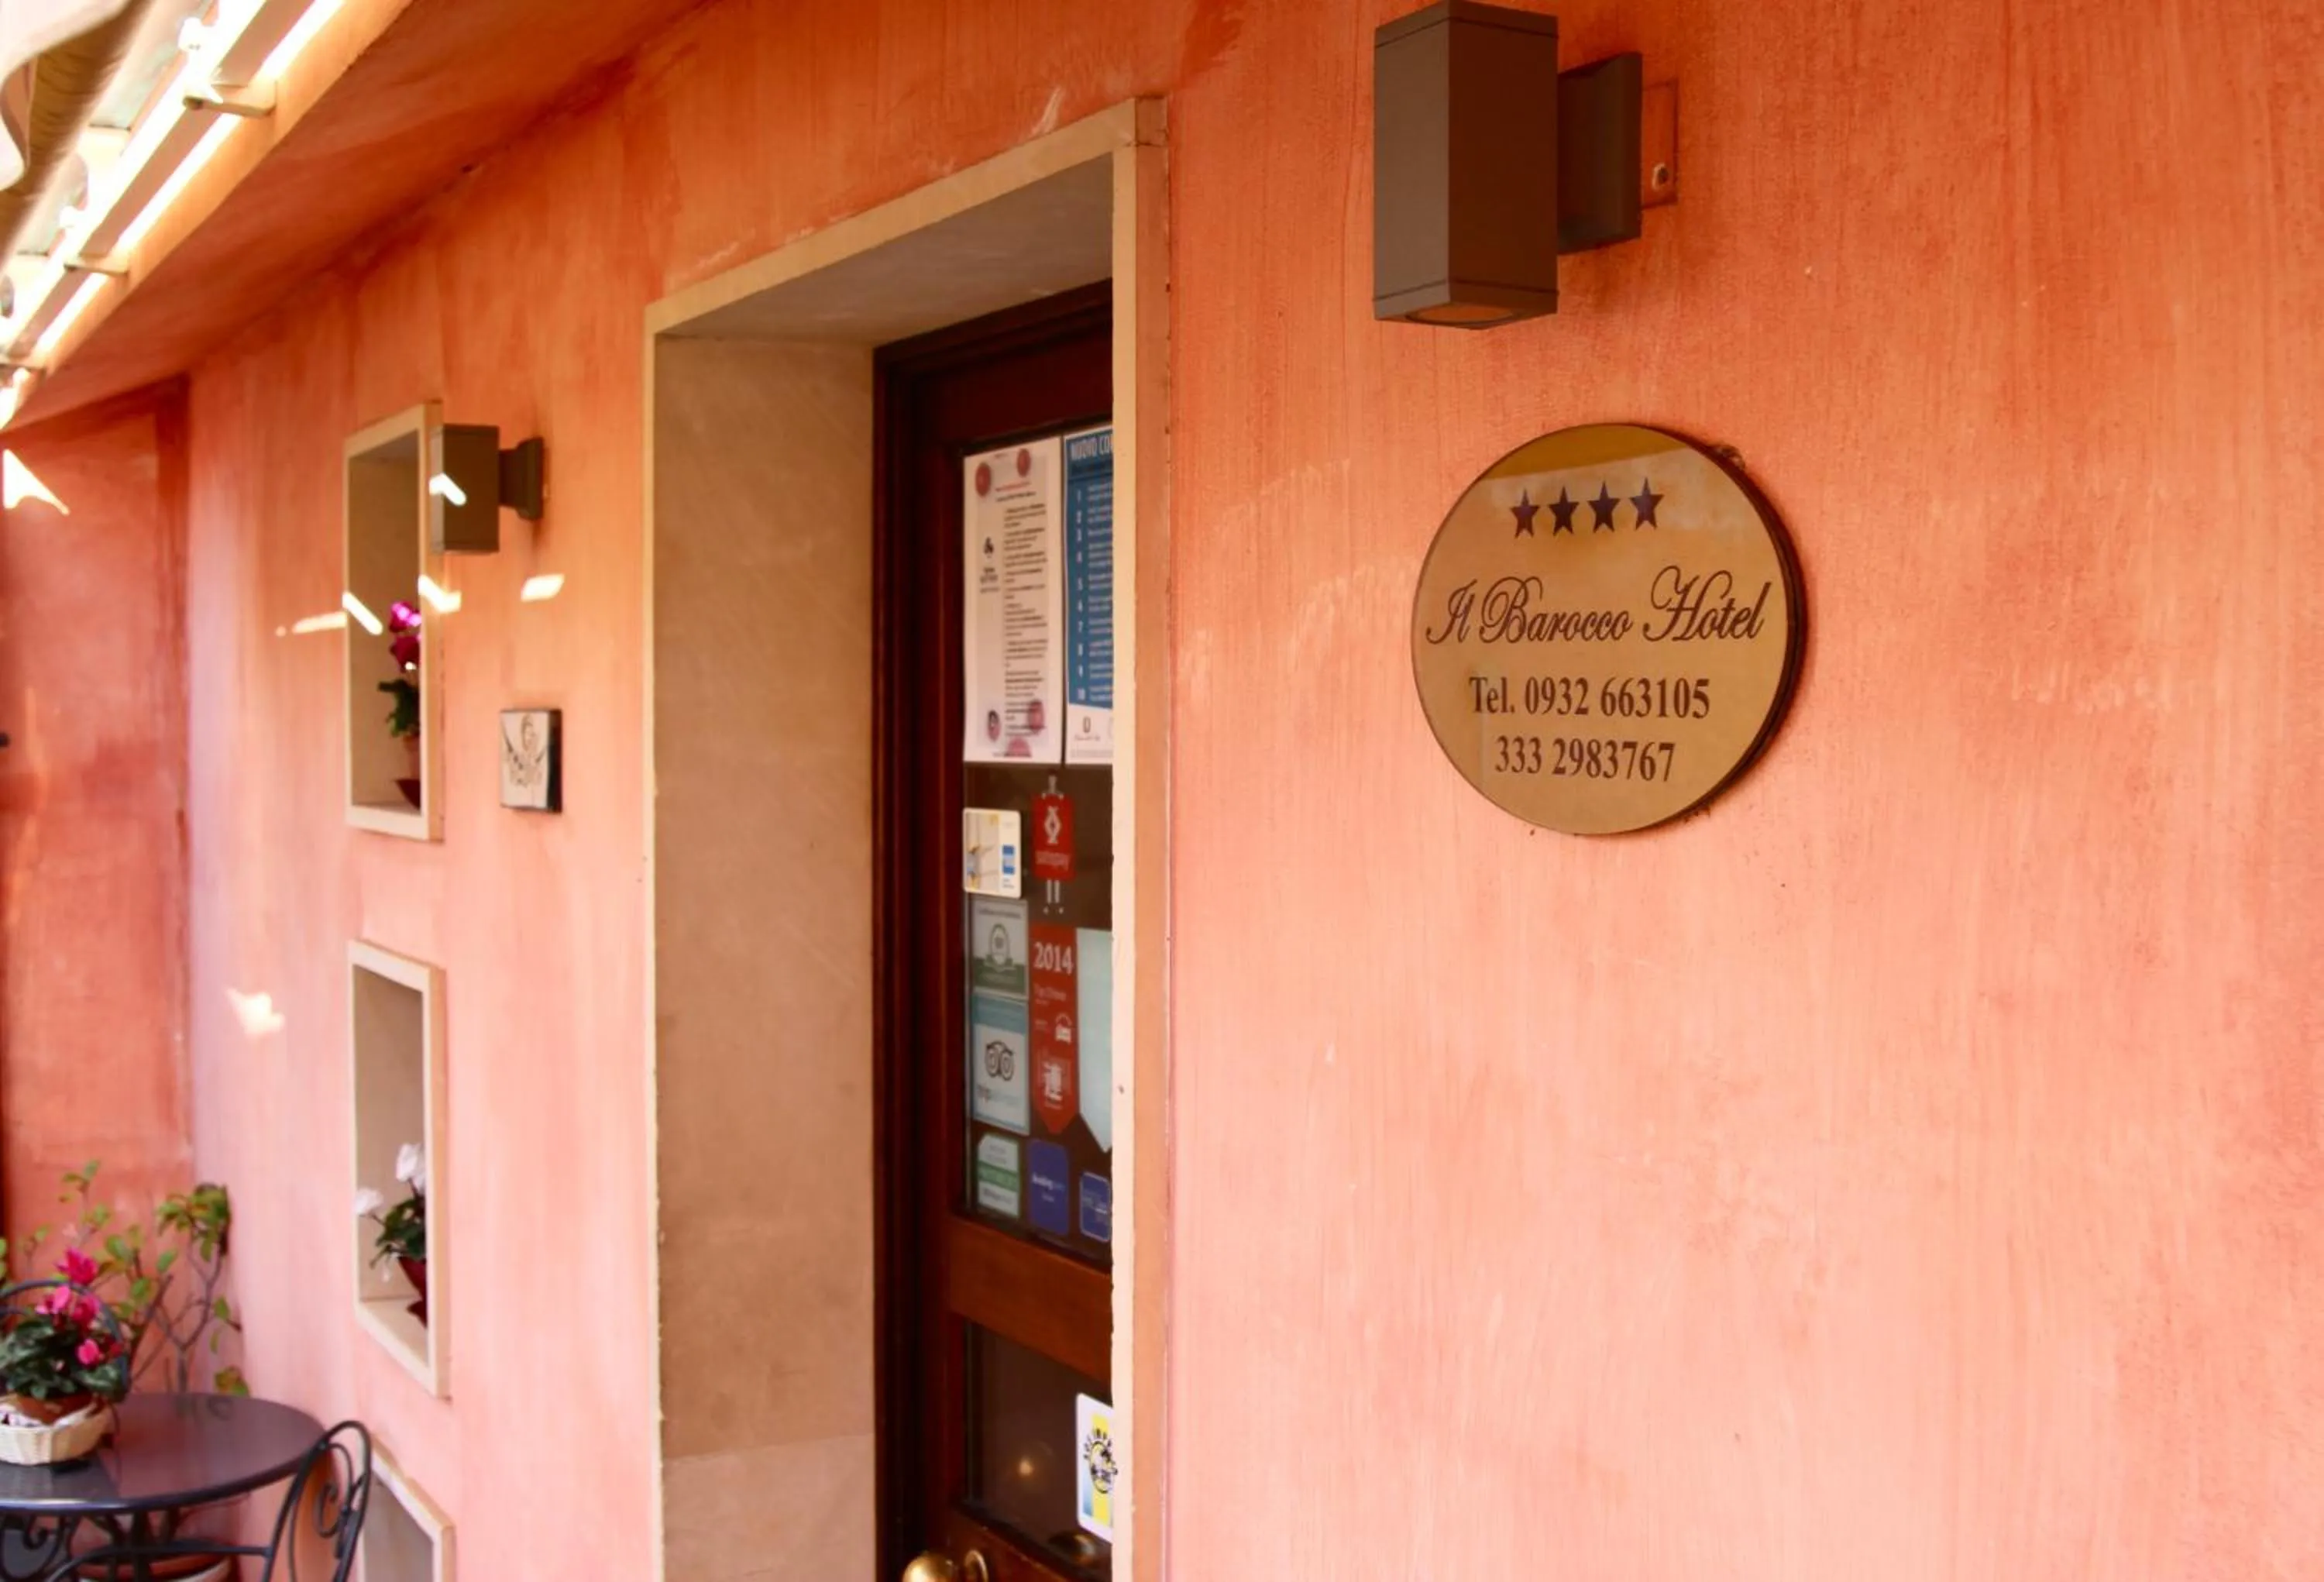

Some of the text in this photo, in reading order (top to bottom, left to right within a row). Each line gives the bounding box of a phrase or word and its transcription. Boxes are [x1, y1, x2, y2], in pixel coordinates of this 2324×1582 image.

[1425, 565, 1772, 645] Il Barocco Hotel
[1469, 676, 1710, 719] Tel. 0932 663105
[1495, 735, 1676, 782] 333 2983767
[1033, 941, 1074, 975] 2014
